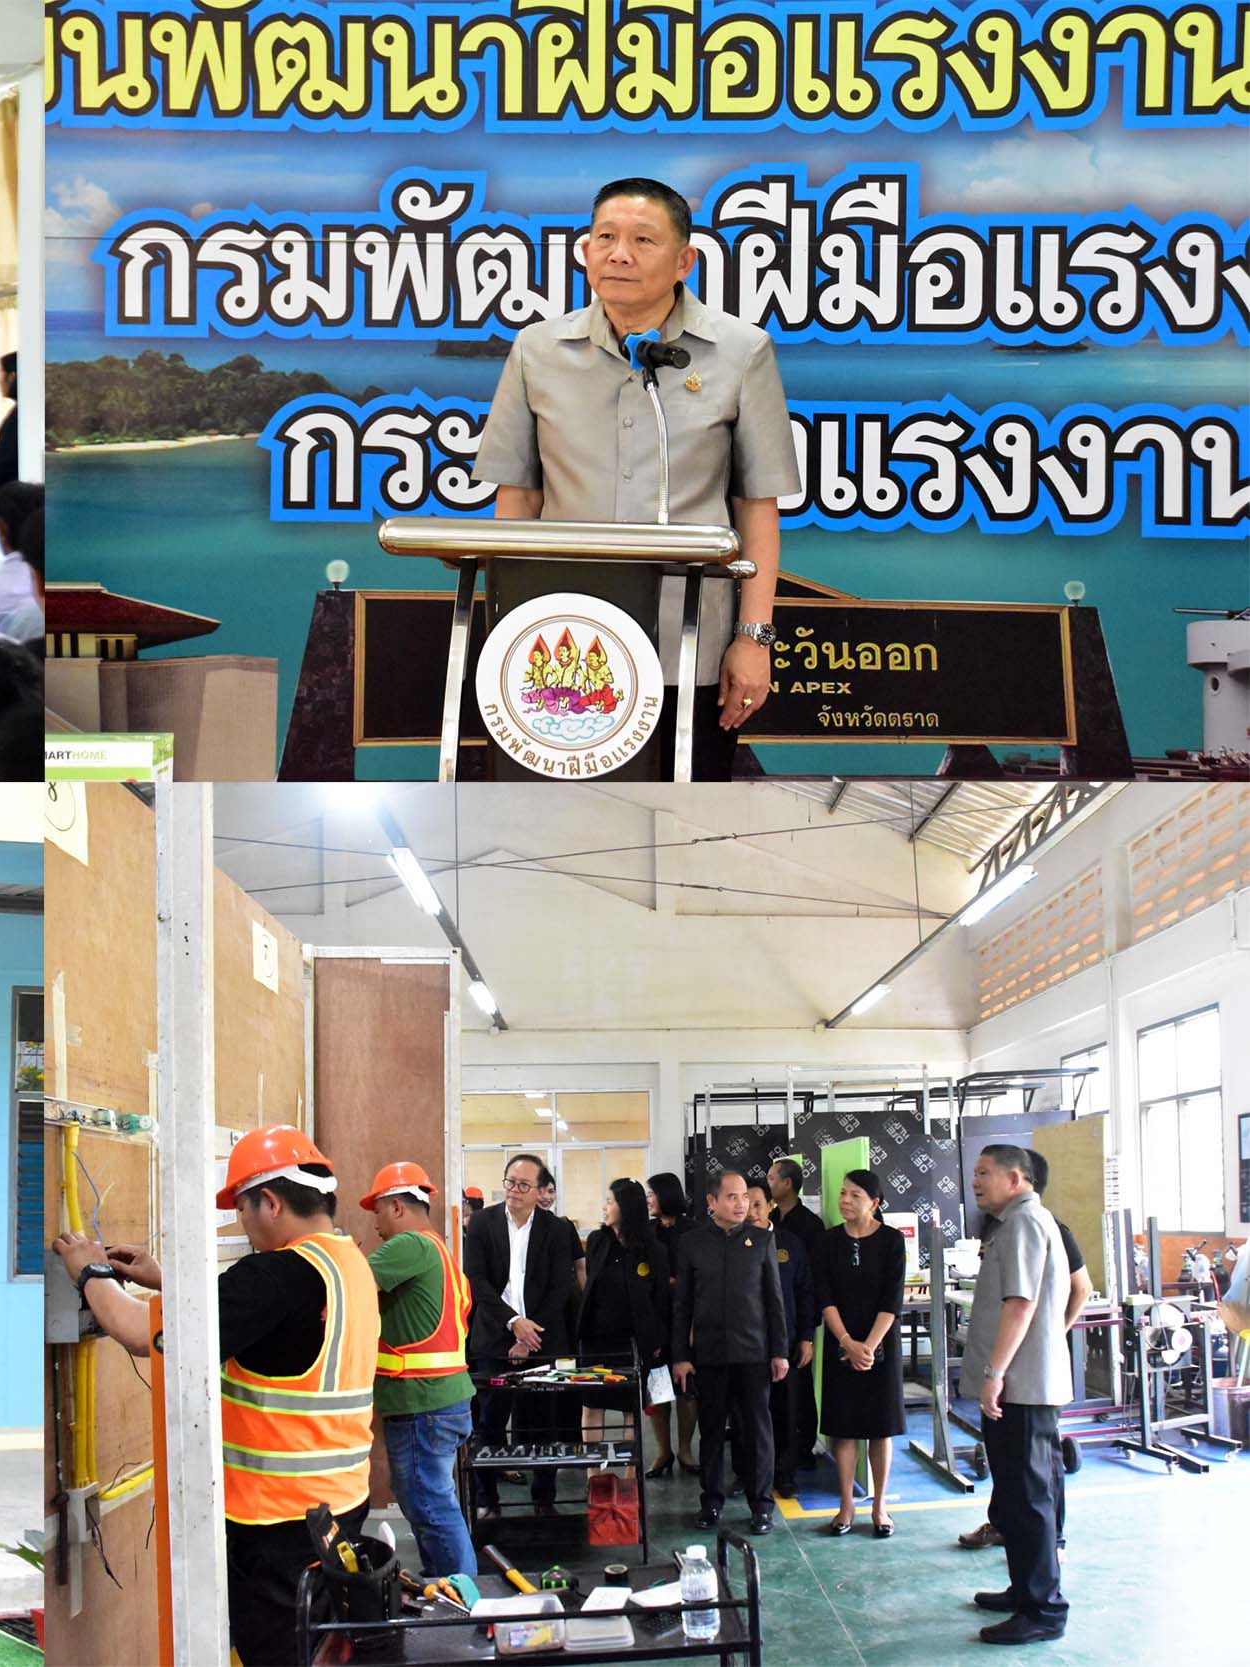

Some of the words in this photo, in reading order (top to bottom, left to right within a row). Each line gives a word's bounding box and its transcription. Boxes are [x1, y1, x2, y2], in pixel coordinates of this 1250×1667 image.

[790, 681, 852, 695] APEX
[817, 704, 940, 728] จังหวัดตราด
[484, 696, 659, 776] กรมพัฒนาฝีมือแรงงาน
